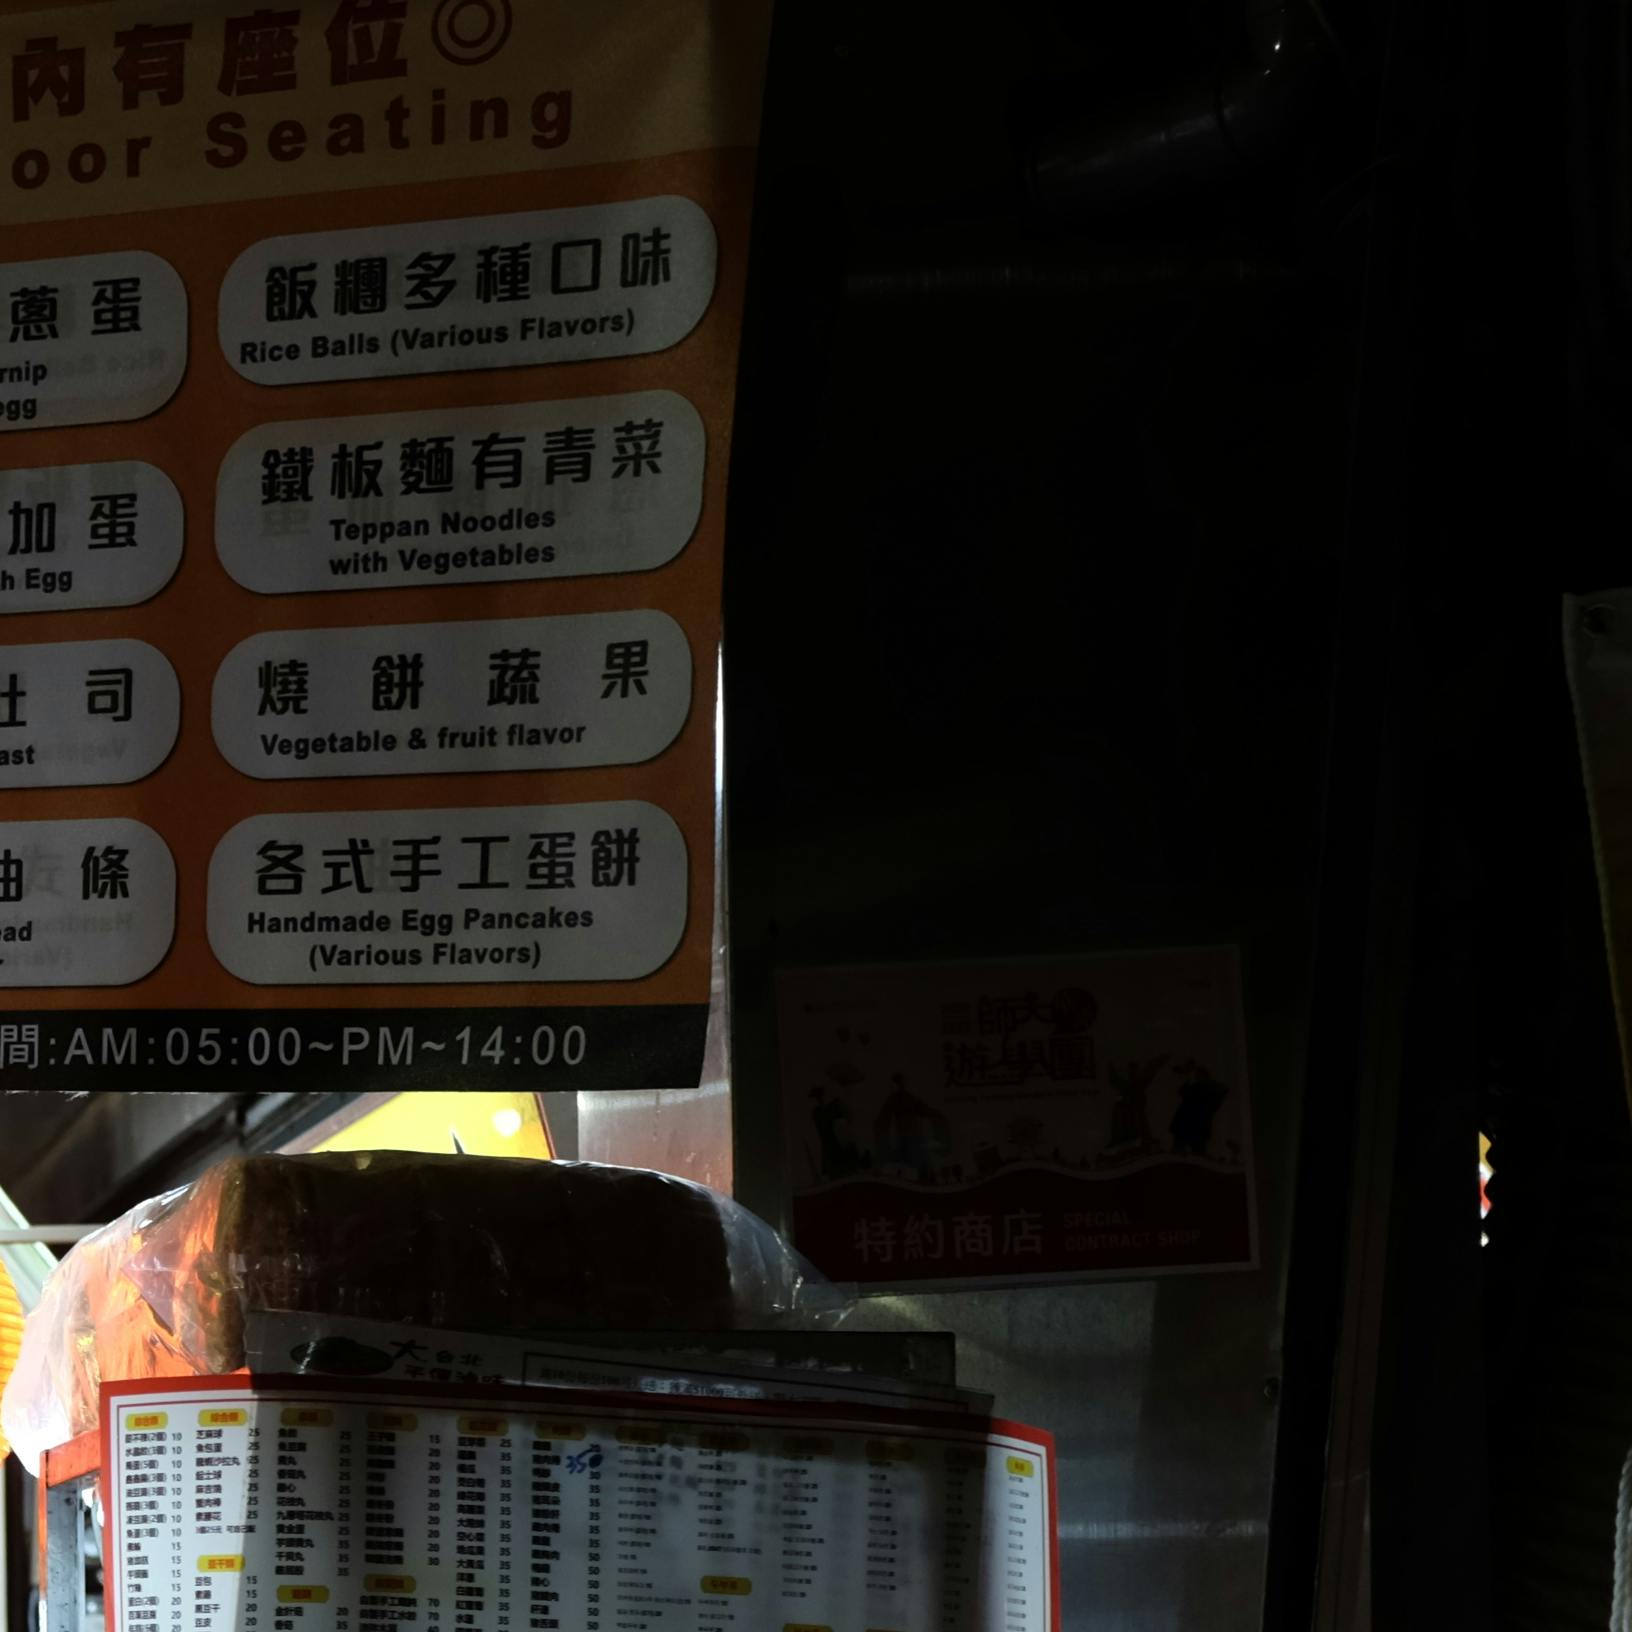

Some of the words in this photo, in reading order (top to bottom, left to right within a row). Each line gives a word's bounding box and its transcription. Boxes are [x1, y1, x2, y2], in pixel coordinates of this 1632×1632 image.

[205, 77, 572, 168] Seating
[265, 226, 672, 322] 飯糰多種口味
[240, 341, 300, 364] Rice
[312, 333, 380, 358] Balls
[391, 325, 509, 357] (Various
[520, 308, 634, 341] Flavors)
[262, 419, 663, 505] 鐵板麵有青菜
[329, 519, 429, 544] Teppan
[441, 508, 555, 534] Noodles
[329, 551, 387, 575] with
[398, 543, 554, 575] Vegetables
[25, 568, 72, 593] Egg
[258, 640, 648, 716] 燒餅蔬果
[261, 730, 397, 760] Vegetable
[408, 728, 427, 750] &
[438, 726, 497, 749] fruit
[507, 724, 586, 746] flavor
[256, 830, 640, 895] 各式手工蛋餅
[248, 910, 391, 933] Handmade
[402, 909, 453, 936] Egg
[464, 907, 593, 930] Pancakes
[310, 944, 422, 971] (Various
[433, 941, 541, 969] Flavors)
[1063, 1210, 1132, 1231] SPECIAL
[853, 1210, 1048, 1265] 特約商店
[1064, 1231, 1152, 1254] CONTRACT
[1157, 1228, 1202, 1248] SHOP
[389, 1339, 483, 1365] 大台北
[172, 1432, 182, 1441] 10
[249, 1426, 262, 1439] 25
[429, 1435, 440, 1444] 15
[500, 1439, 511, 1447] 25
[172, 1446, 182, 1454] 10
[249, 1440, 262, 1452] 25
[340, 1445, 351, 1453] 25
[340, 1458, 351, 1467] 25
[249, 1467, 260, 1480] 25
[339, 1472, 351, 1480] 25
[339, 1499, 351, 1508] 25
[339, 1513, 350, 1522] 25
[339, 1526, 350, 1535] 25
[500, 1534, 511, 1542] 35
[500, 1561, 511, 1570] 35
[247, 1576, 257, 1584] 15
[246, 1589, 257, 1598] 15
[246, 1603, 257, 1612] 20
[428, 1597, 440, 1607] 70
[246, 1617, 257, 1626] 20
[428, 1612, 439, 1621] 70
